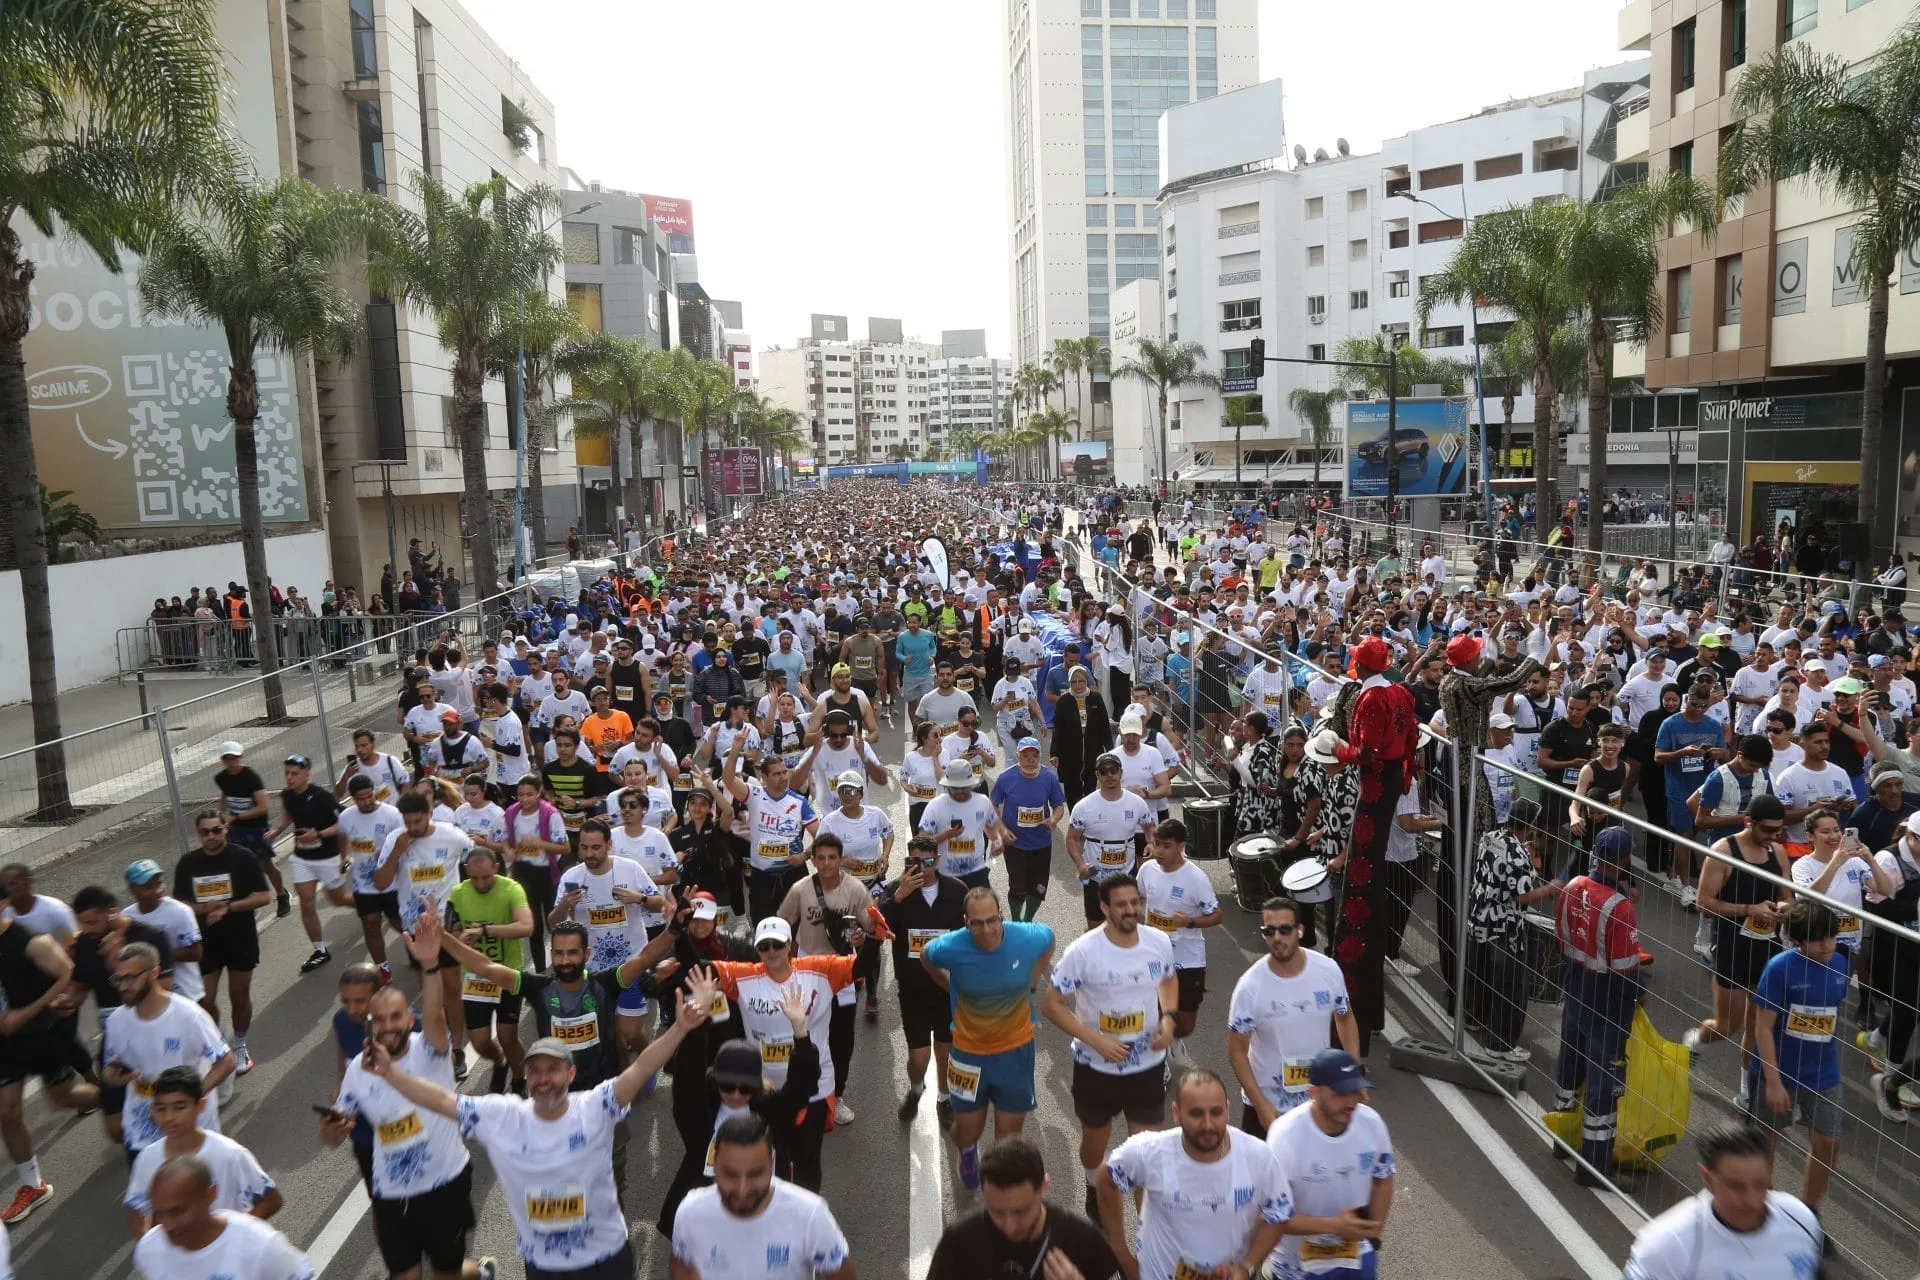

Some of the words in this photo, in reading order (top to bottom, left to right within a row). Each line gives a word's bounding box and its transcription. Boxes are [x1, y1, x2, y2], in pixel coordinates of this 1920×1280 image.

[31, 382, 67, 399] SCAN
[68, 380, 91, 396] ME
[759, 811, 780, 827] Tjri
[761, 845, 785, 853] 17472
[591, 909, 623, 921] 14904
[554, 1022, 595, 1038] 13253
